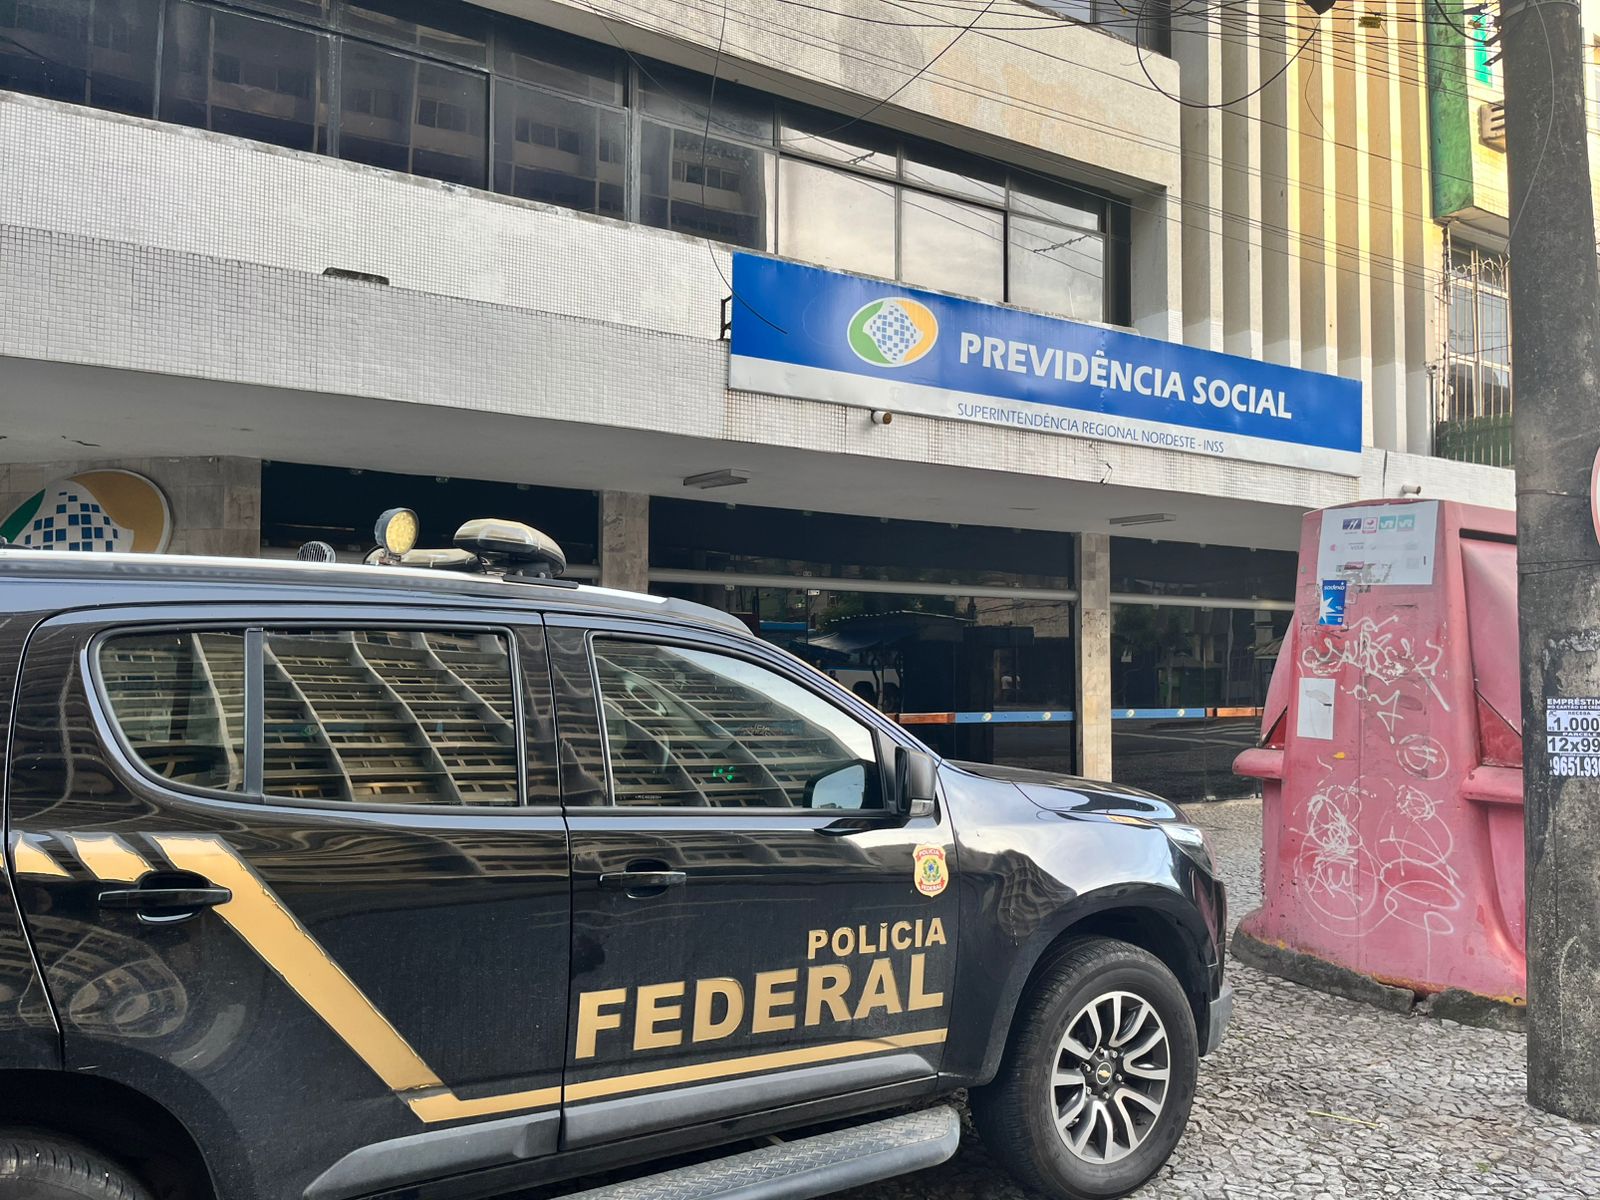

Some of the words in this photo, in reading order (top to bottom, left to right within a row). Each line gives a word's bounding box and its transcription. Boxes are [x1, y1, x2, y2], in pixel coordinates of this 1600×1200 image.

[960, 332, 1185, 402] PREVIDÊNCIA
[1193, 375, 1293, 420] SOCIAL
[1082, 421, 1139, 441] REGIONAL
[1141, 430, 1196, 449] NORDESTE
[1203, 440, 1225, 453] INSS
[574, 953, 945, 1060] FEDERAL
